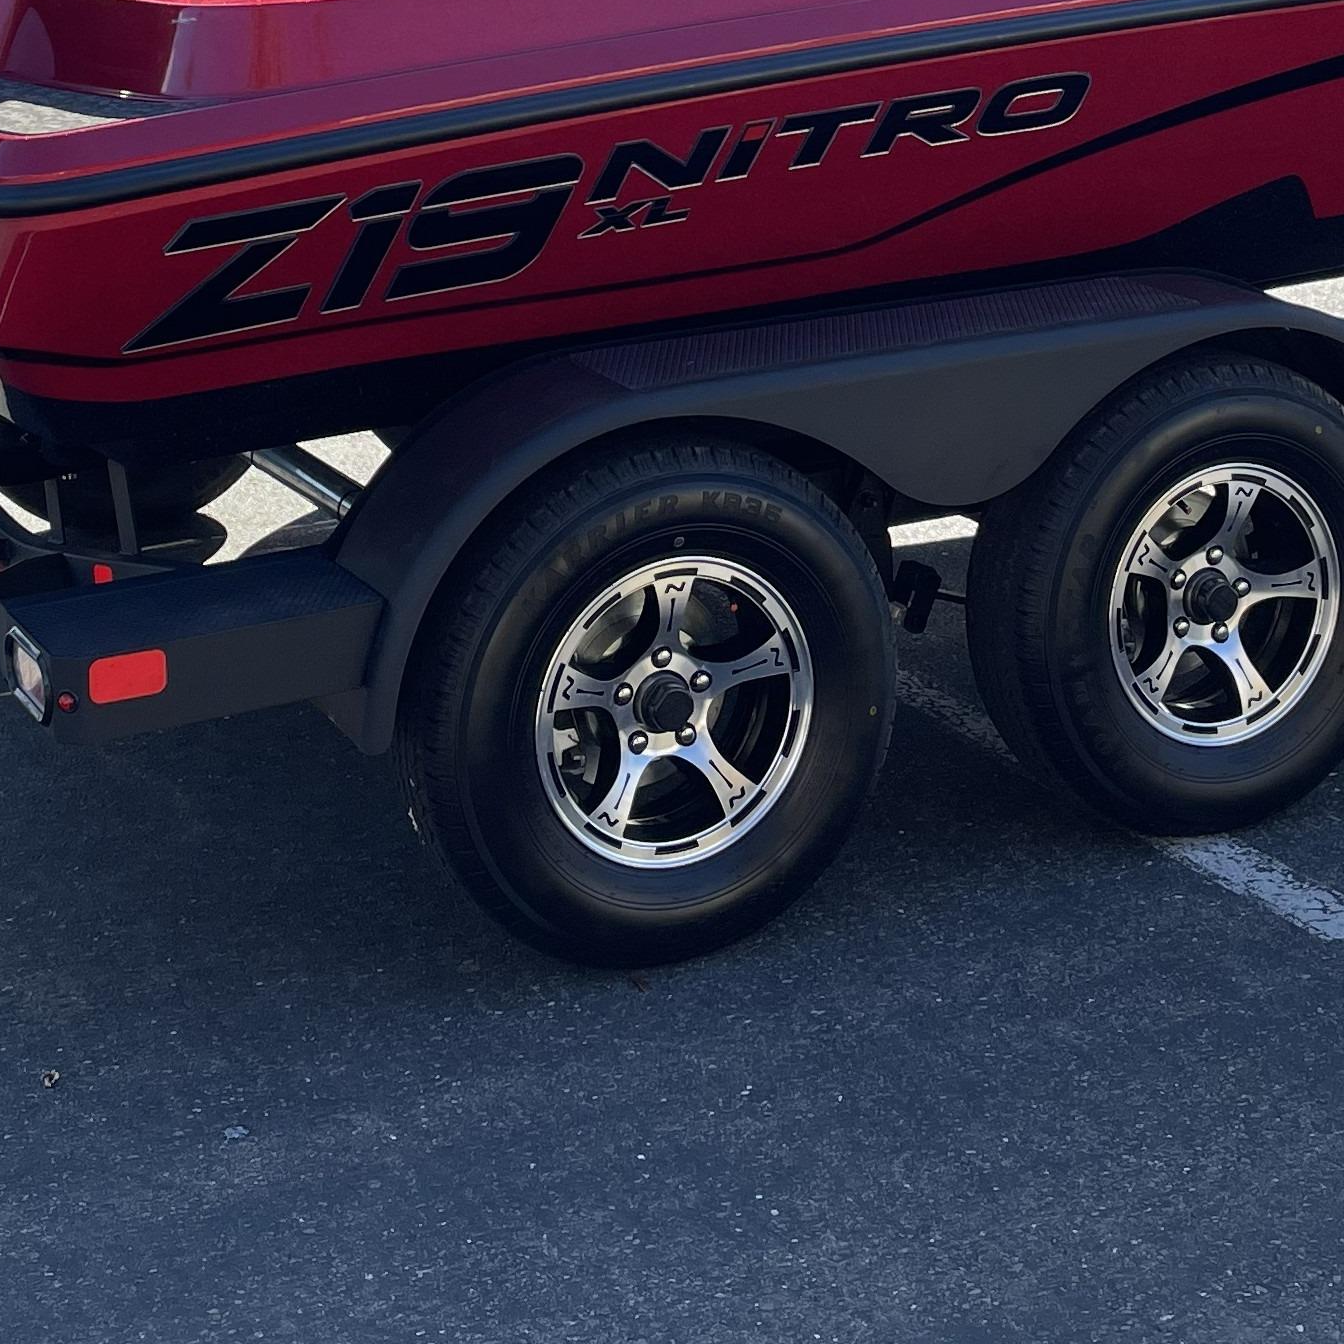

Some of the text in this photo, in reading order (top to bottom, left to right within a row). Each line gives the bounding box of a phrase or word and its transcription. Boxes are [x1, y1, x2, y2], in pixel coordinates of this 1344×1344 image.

[584, 70, 1092, 206] NITRO
[121, 151, 585, 354] Z19
[577, 194, 693, 240] XL
